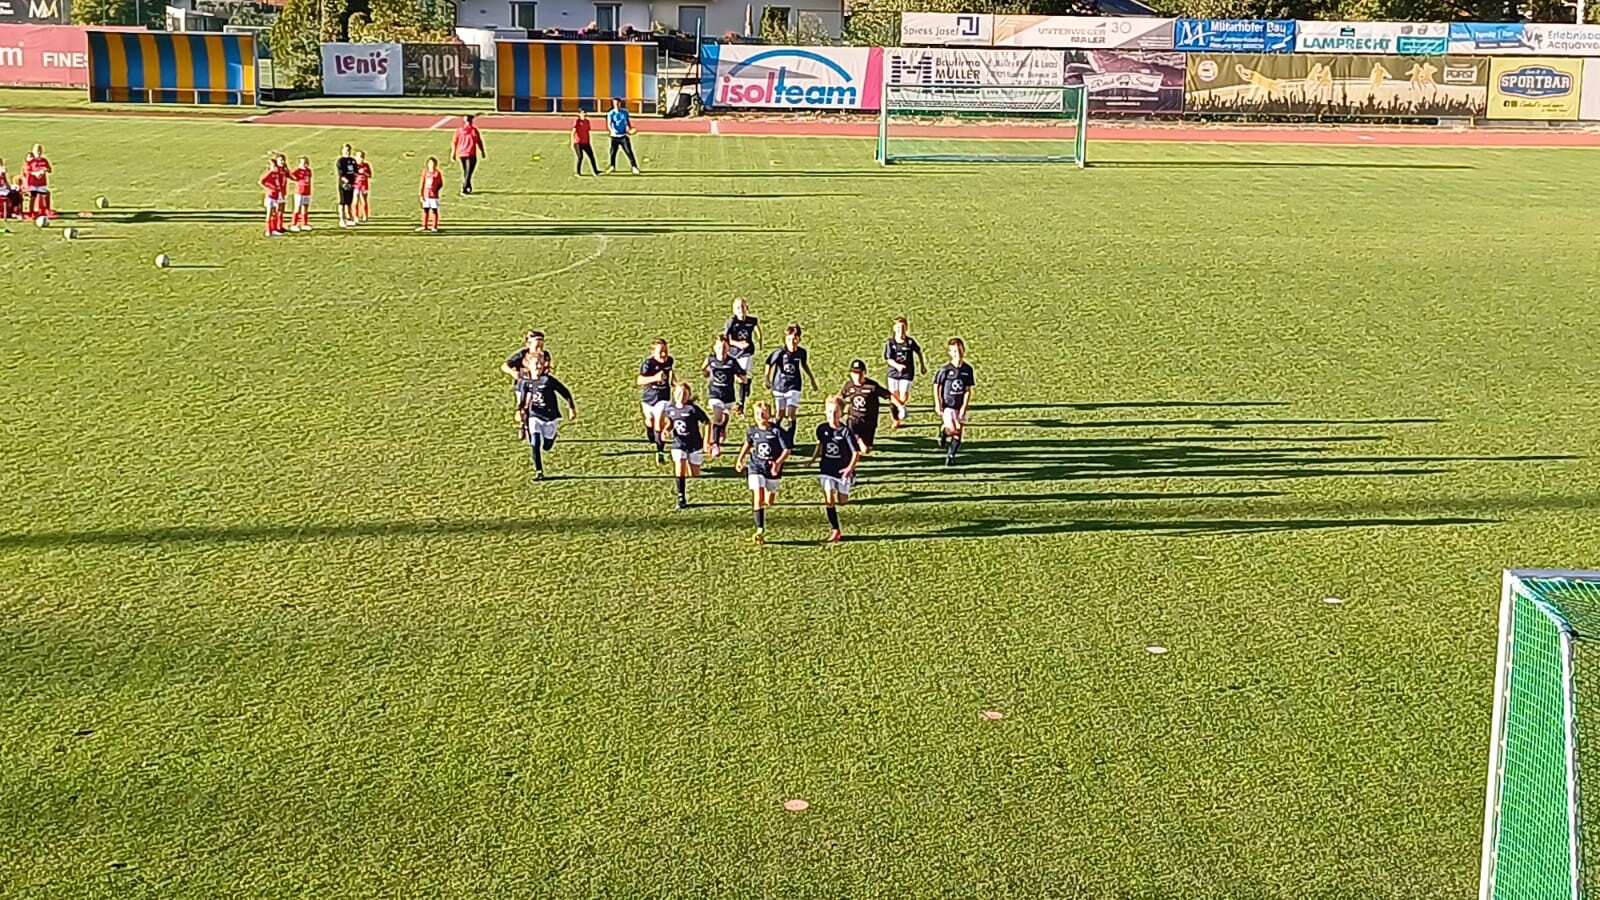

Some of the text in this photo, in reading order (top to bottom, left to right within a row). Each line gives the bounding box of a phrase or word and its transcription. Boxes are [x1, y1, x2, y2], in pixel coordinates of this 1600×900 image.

[1303, 38, 1391, 50] LAMPRECHT
[720, 66, 857, 105] isolteam
[1501, 75, 1570, 89] SPORTBAR
